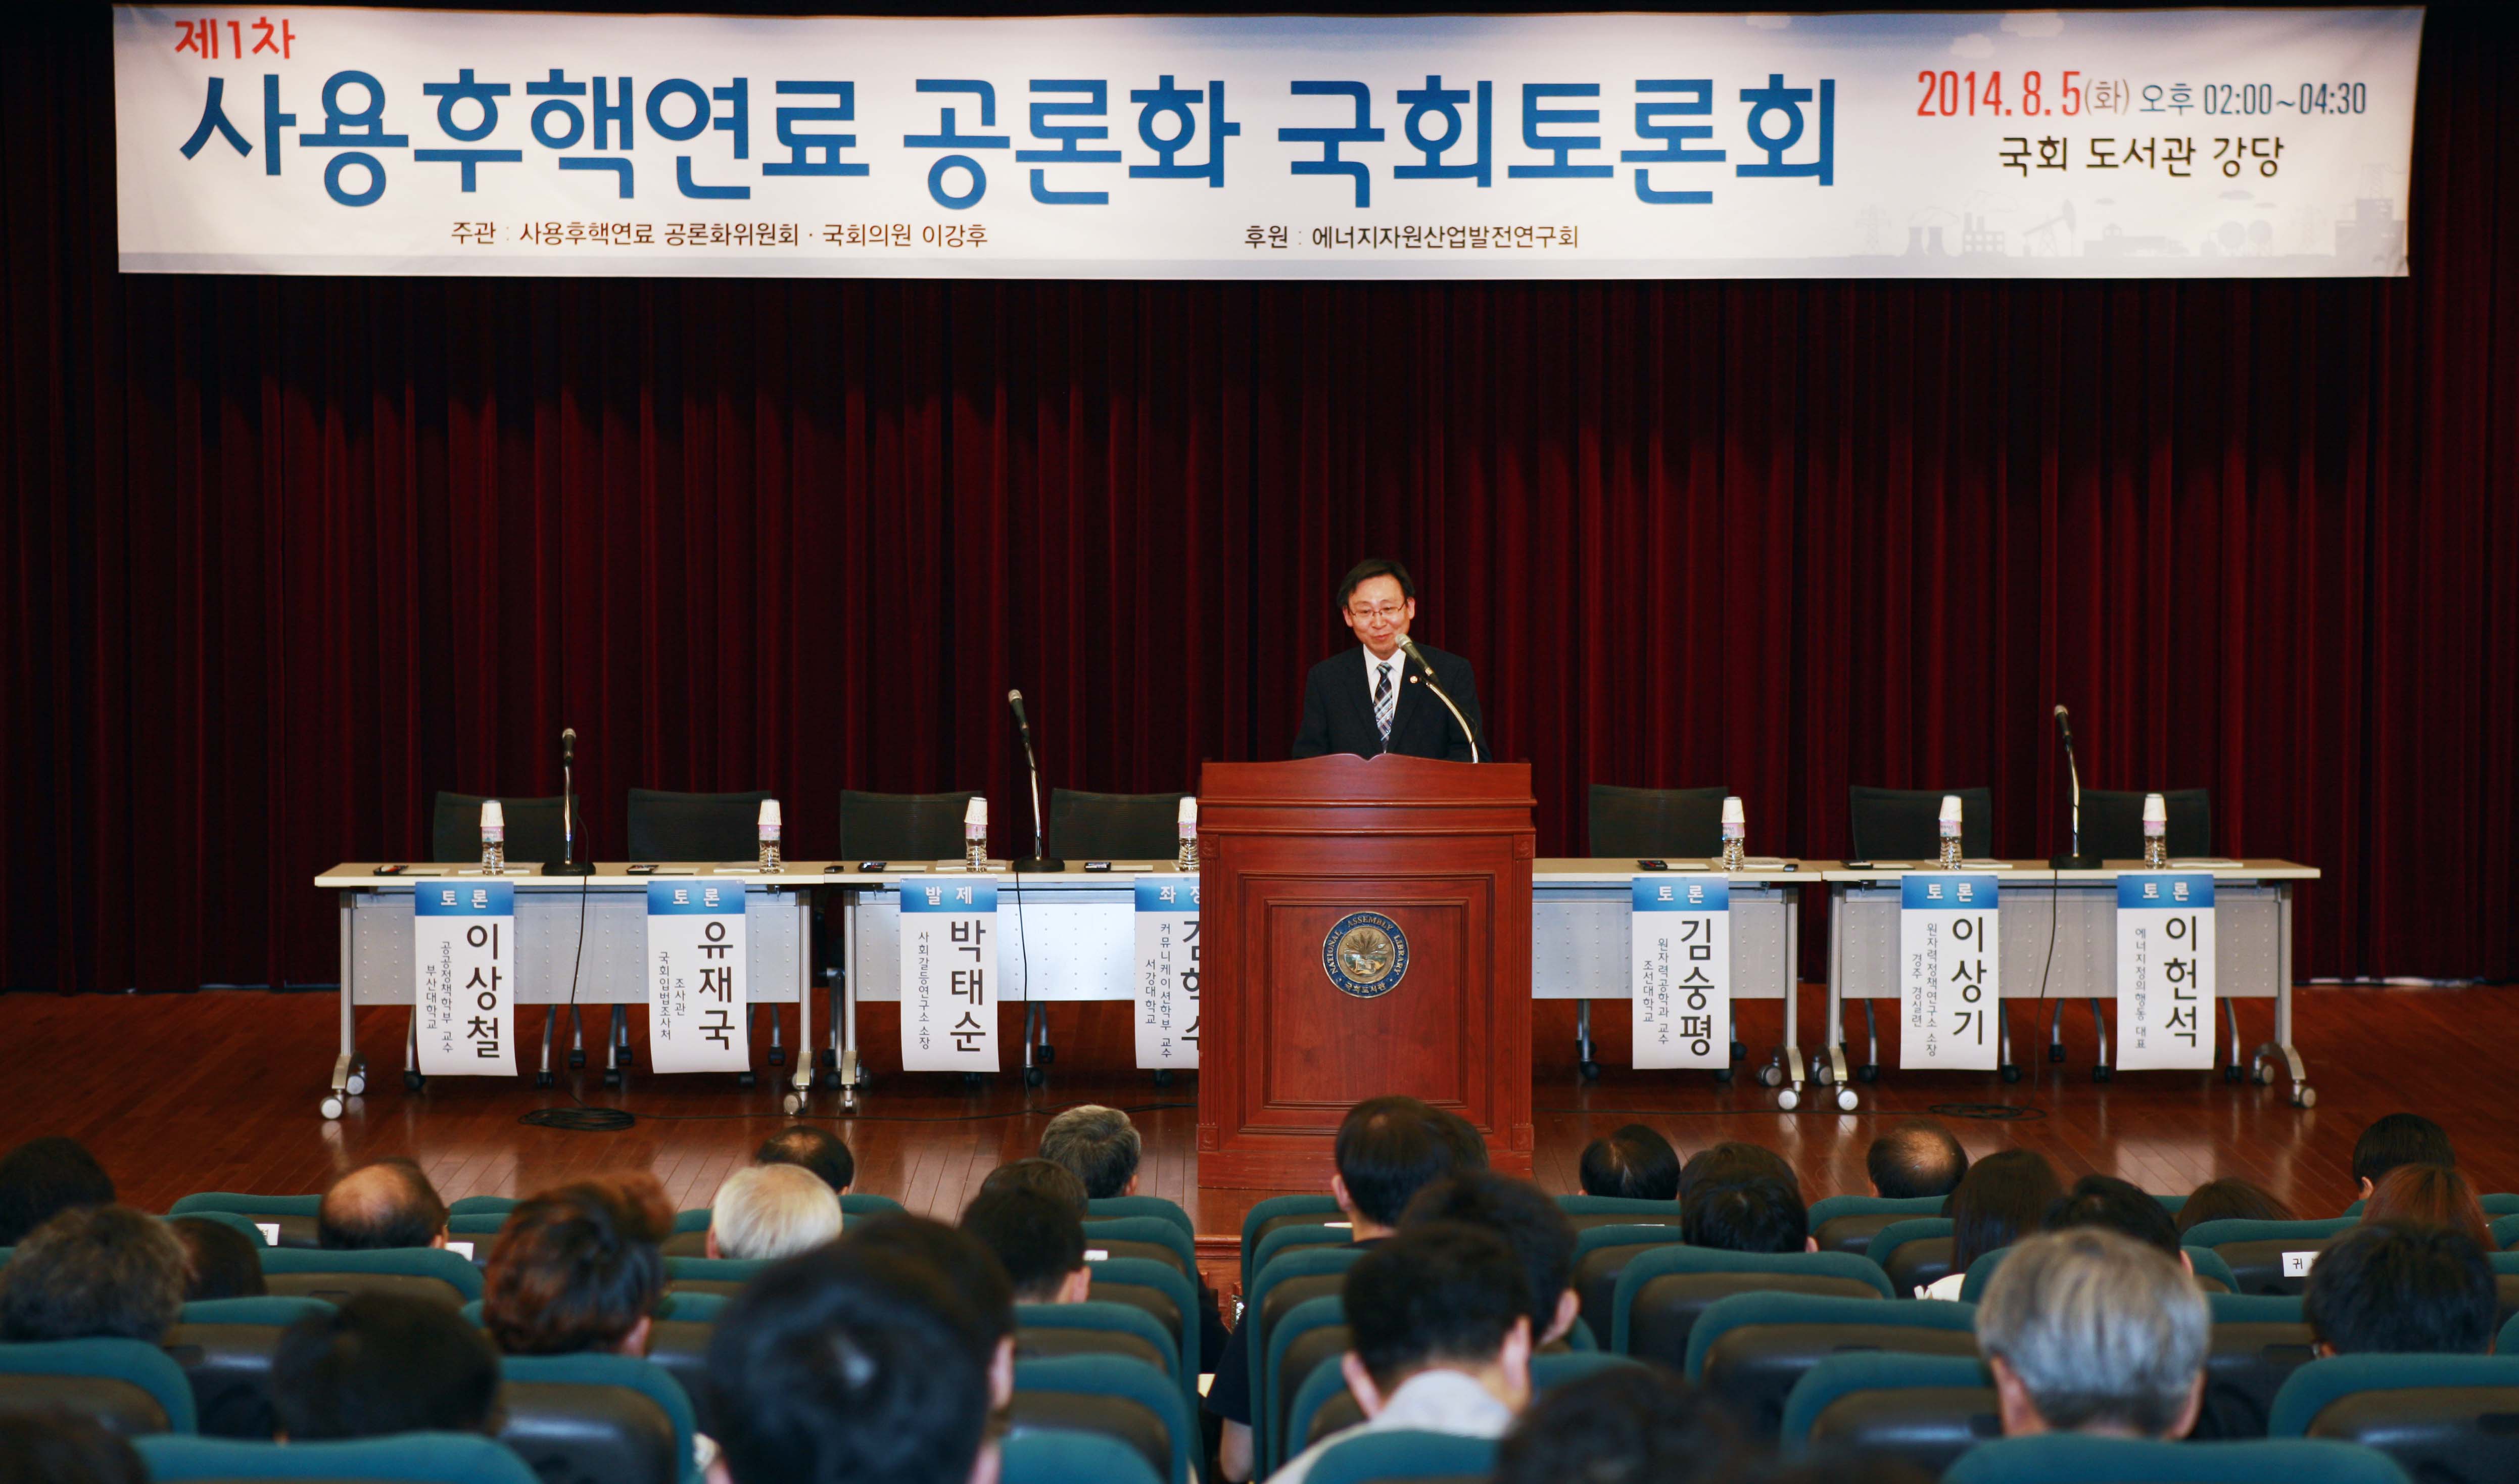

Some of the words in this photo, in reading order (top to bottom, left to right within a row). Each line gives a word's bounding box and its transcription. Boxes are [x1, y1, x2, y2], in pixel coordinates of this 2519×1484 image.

[174, 17, 296, 60] 제1차
[2140, 83, 2194, 115] 오후
[179, 68, 870, 207] 사용후핵연료
[904, 75, 1241, 210] 공론화
[1999, 135, 2067, 178] 국회
[2086, 137, 2197, 177] 도서관
[2213, 136, 2285, 178] 강당
[451, 221, 496, 245] 주관
[519, 222, 655, 246] 사용후핵연료
[664, 223, 798, 247] 공론화위원회
[823, 224, 911, 247] 국회의원
[923, 224, 987, 248] 이강후
[1245, 225, 1288, 249] 후원
[1312, 226, 1577, 249] 에너지자원산업발전연구회
[1327, 931, 1342, 975] NATIONAL
[1348, 916, 1393, 931] ASSEMBLY
[1394, 935, 1405, 975] LIBRARY
[1914, 954, 1921, 978] 경주
[1927, 924, 1937, 1027] 원자력정책연구소
[426, 966, 437, 1028] 부산대학교
[442, 942, 451, 1023] 공공정책학부
[465, 923, 502, 1058] 이상철
[659, 952, 670, 1040] 국회입법조사처
[675, 979, 685, 1016] 조사관
[698, 922, 735, 1050] 유재국
[919, 932, 929, 1021] 사회갈등연구소
[950, 920, 986, 1052] 박태순
[1146, 960, 1156, 1023] 서강대학교
[1160, 924, 1171, 1030] 커뮤니케이션학부
[1643, 961, 1653, 1022] 조선대학교
[1658, 939, 1669, 1017] 원자력공학과
[1679, 919, 1715, 1057] 김숭평
[1912, 987, 1921, 1027] 경실련
[1951, 917, 1987, 1045] 이상기
[2164, 916, 2197, 1048] 이헌석
[443, 1032, 453, 1052] 교수
[920, 1027, 930, 1049] 소장
[1161, 1038, 1171, 1058] 교수
[1658, 1024, 1668, 1044] 교수
[1927, 1034, 1936, 1056] 소장
[2136, 1028, 2145, 1047] 대표
